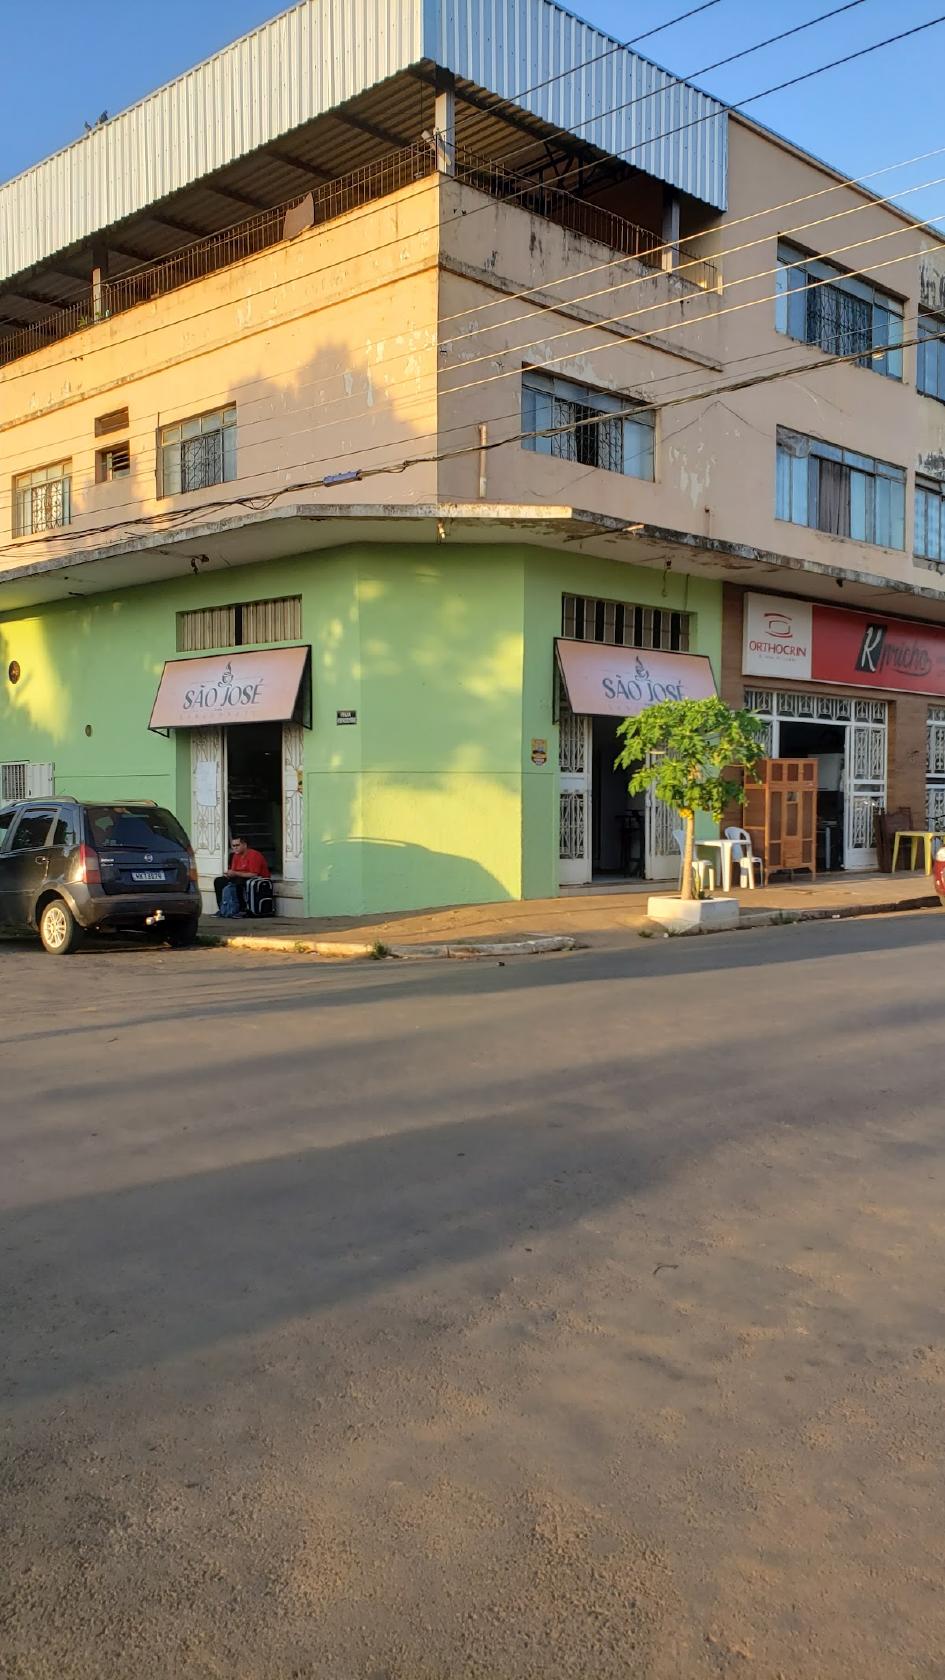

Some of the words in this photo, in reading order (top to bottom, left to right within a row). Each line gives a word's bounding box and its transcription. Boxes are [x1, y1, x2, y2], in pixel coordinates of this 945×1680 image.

[749, 640, 807, 657] ORTHOCRIN
[183, 684, 218, 710] SÃO
[220, 678, 264, 707] JOSÉ
[602, 674, 642, 701] SÃO
